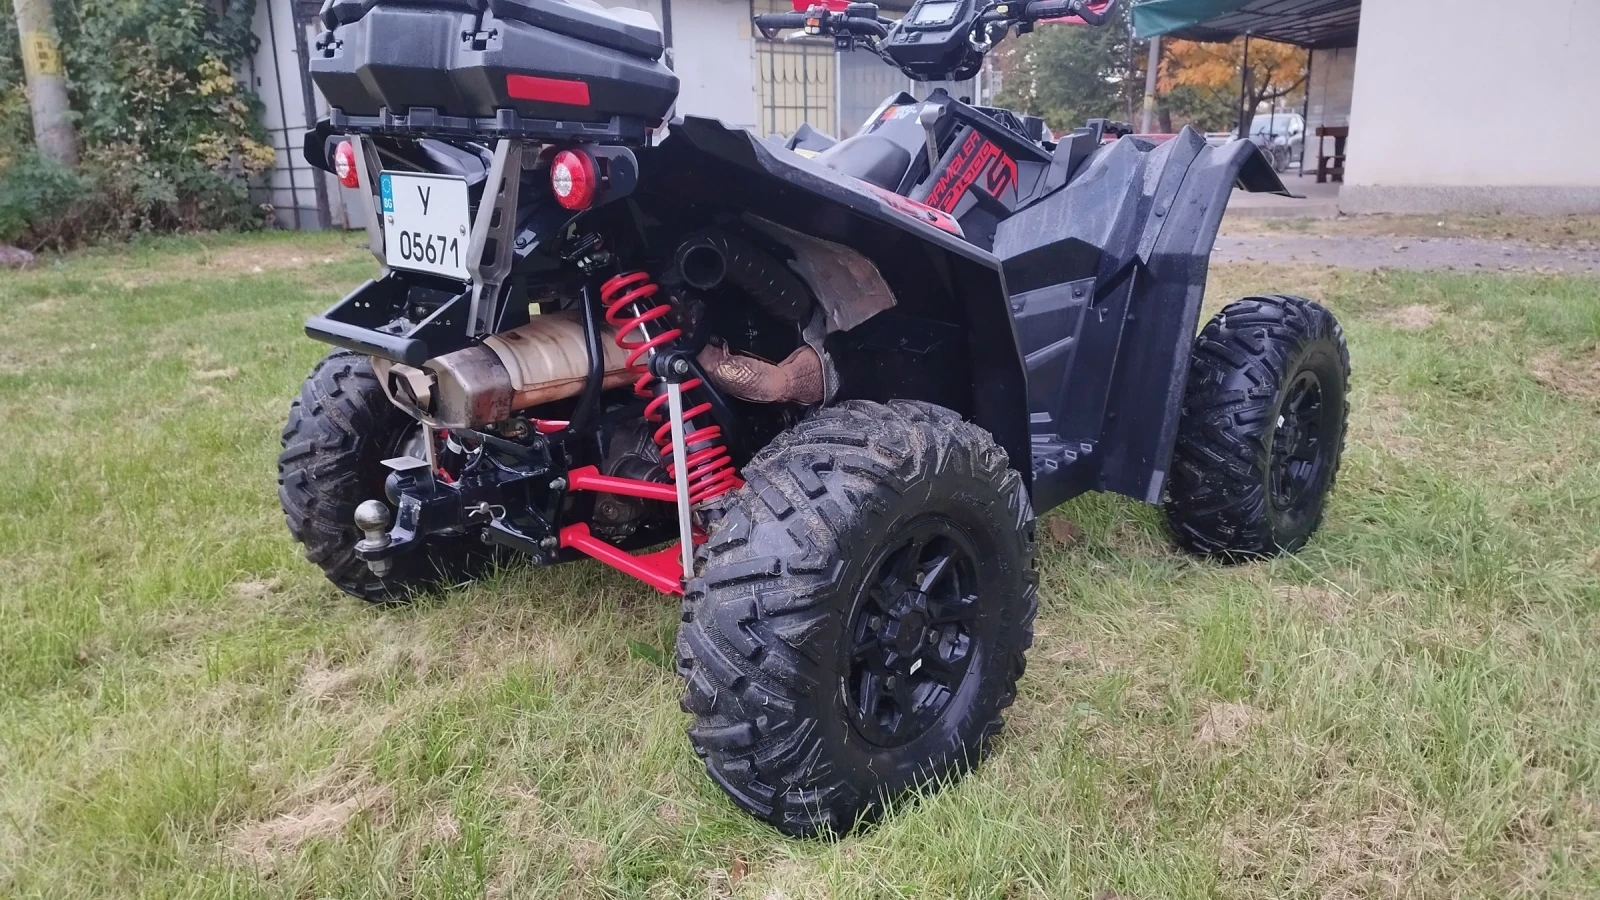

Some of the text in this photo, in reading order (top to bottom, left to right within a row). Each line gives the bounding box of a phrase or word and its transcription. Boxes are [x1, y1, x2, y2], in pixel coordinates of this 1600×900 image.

[923, 130, 981, 206] RAMBLER
[384, 198, 392, 208] BG
[400, 230, 459, 268] 05671
